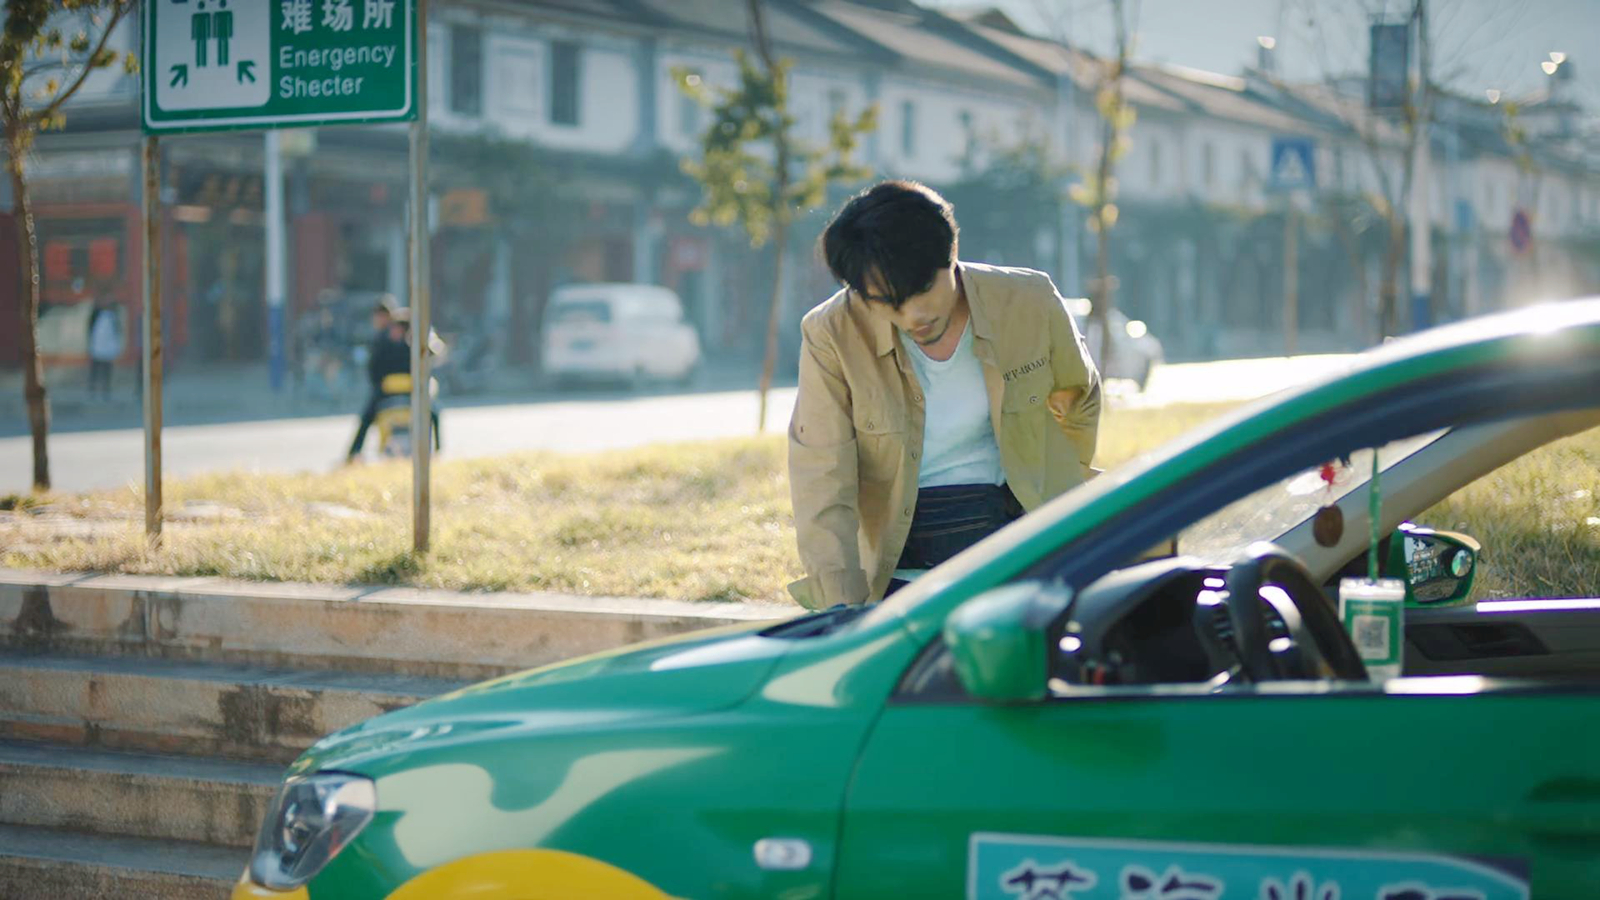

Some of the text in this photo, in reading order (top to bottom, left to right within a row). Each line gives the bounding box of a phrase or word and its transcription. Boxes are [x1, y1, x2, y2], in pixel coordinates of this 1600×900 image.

[281, 0, 395, 34] 难场所
[280, 45, 396, 71] Energency
[279, 75, 364, 99] Shecter
